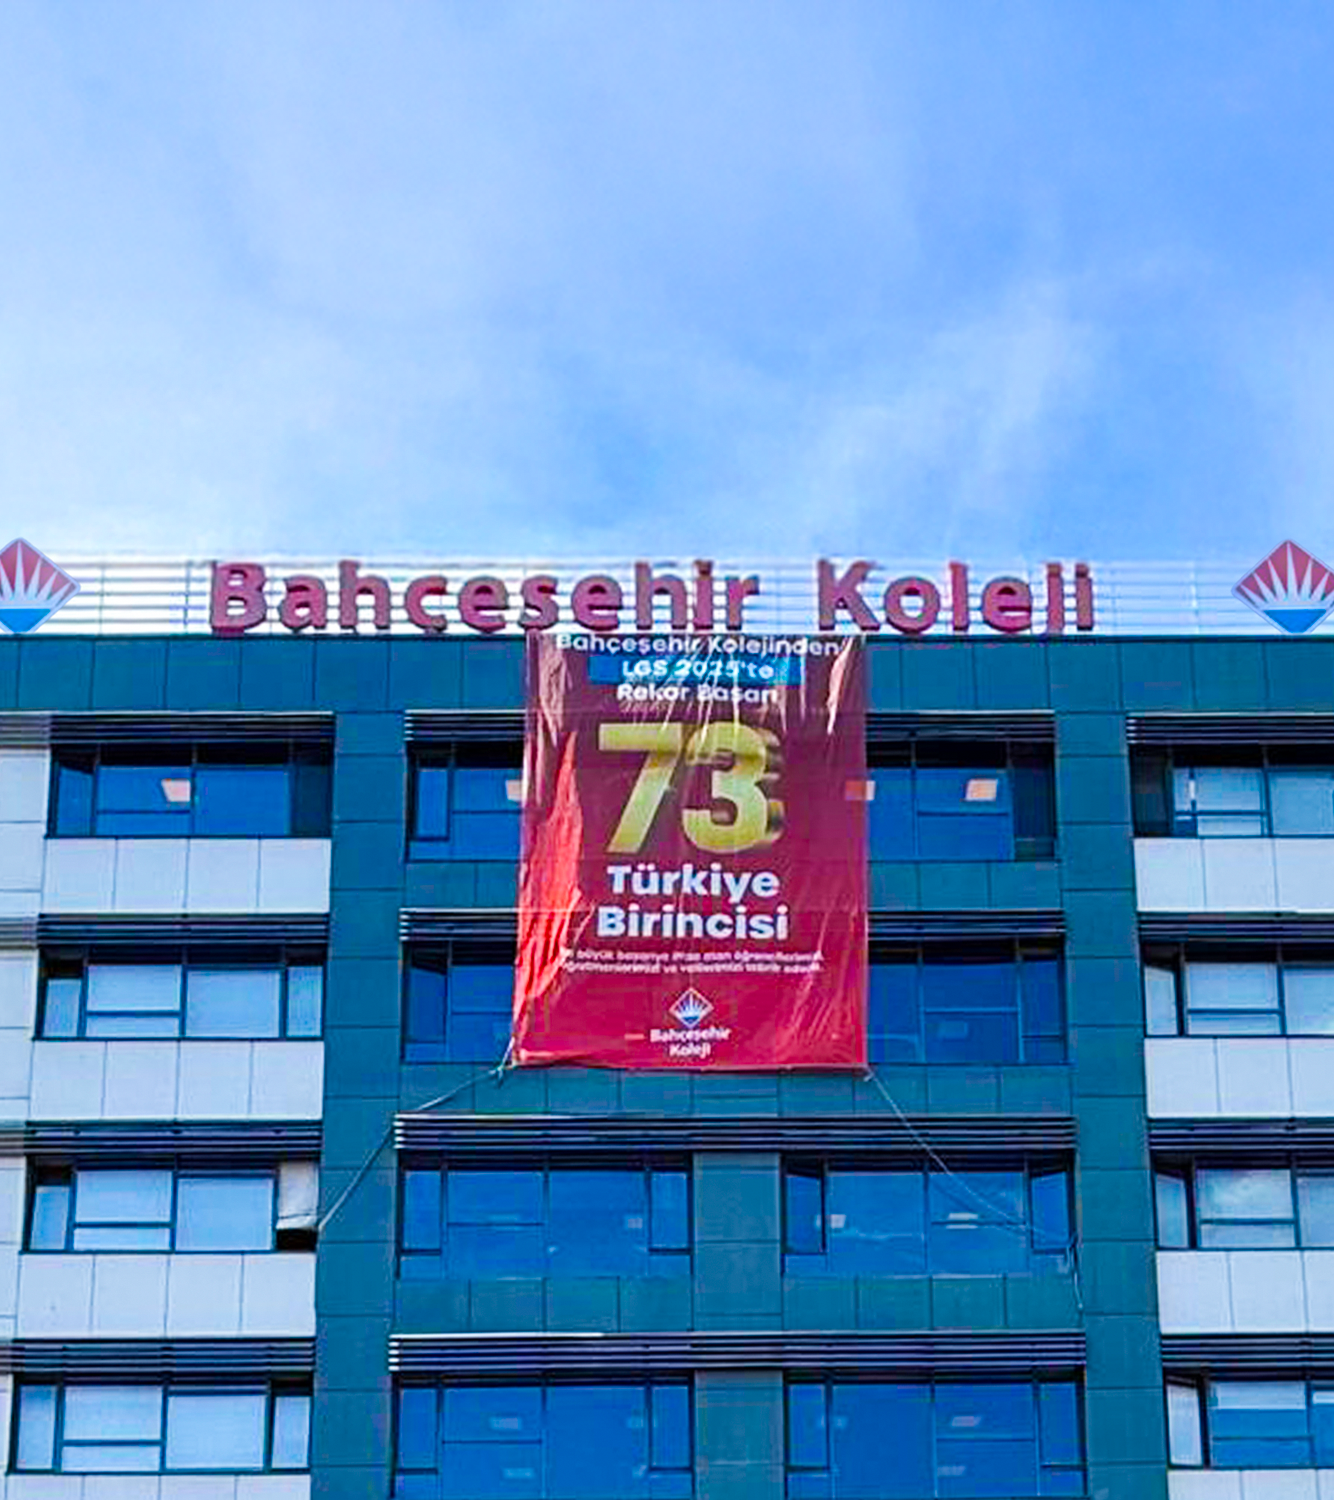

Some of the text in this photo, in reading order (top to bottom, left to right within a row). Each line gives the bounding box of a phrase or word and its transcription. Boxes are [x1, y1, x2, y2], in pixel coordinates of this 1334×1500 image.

[818, 560, 1094, 633] Koleji
[622, 660, 667, 677] LGS
[617, 683, 690, 702] Rekor
[598, 722, 786, 853] 73
[607, 863, 780, 903] Türkiye
[597, 903, 788, 940] Birincisi
